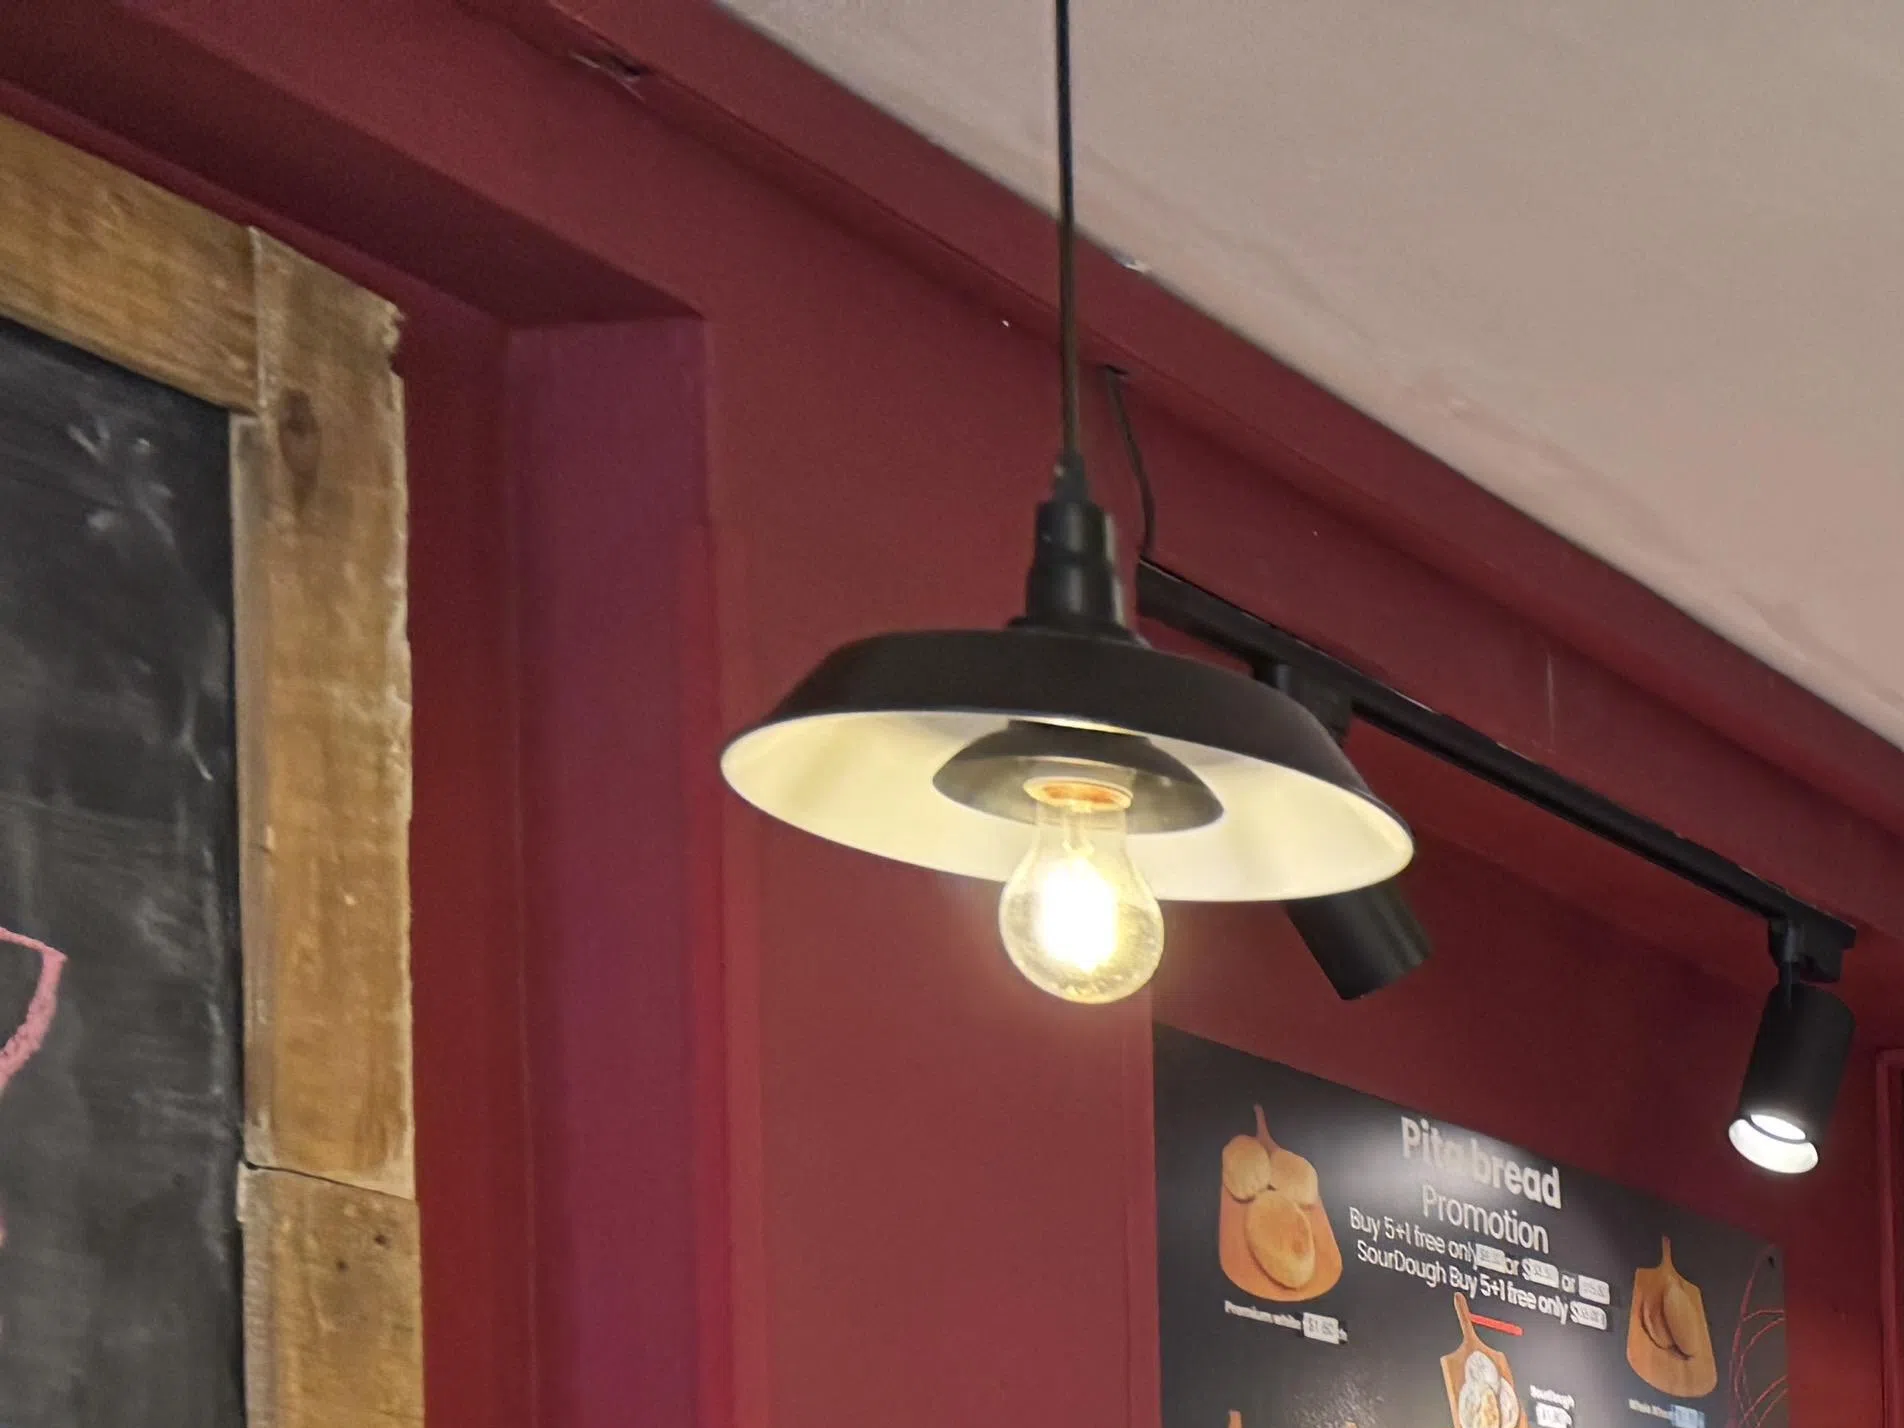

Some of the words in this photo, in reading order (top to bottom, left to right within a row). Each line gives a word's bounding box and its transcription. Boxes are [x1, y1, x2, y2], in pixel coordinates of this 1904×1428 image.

[1401, 1116, 1465, 1172] Pita
[1470, 1138, 1562, 1209] bread
[1349, 1207, 1380, 1242] Buy
[1414, 1224, 1445, 1251] free
[1422, 1184, 1549, 1254] Promotion
[1357, 1239, 1447, 1288] SourDough
[1449, 1266, 1477, 1299] Buy
[1507, 1282, 1536, 1310] free
[1538, 1295, 1568, 1325] only
